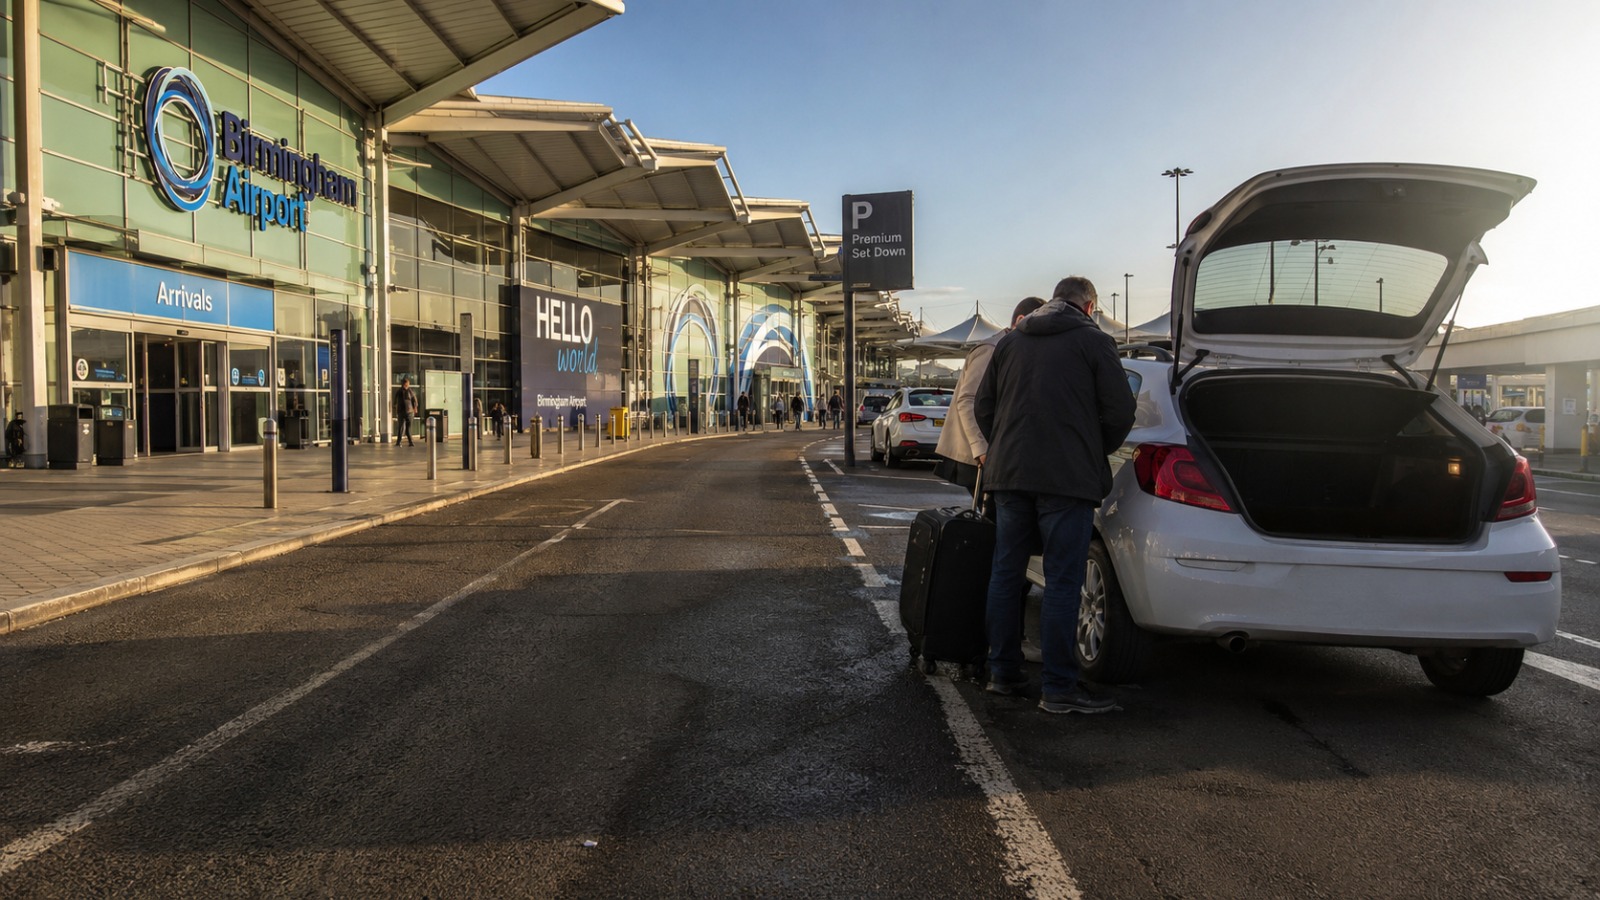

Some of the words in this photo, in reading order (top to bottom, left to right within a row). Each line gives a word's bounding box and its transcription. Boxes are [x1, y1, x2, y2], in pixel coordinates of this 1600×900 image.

[222, 111, 356, 207] Birmingham
[223, 165, 306, 232] Airport
[852, 201, 873, 229] P
[852, 233, 902, 244] Premium
[852, 248, 871, 259] Set
[874, 247, 906, 257] Down
[157, 281, 212, 311] Arrivals
[536, 296, 593, 344] HELLO
[537, 394, 569, 410] Birmingham
